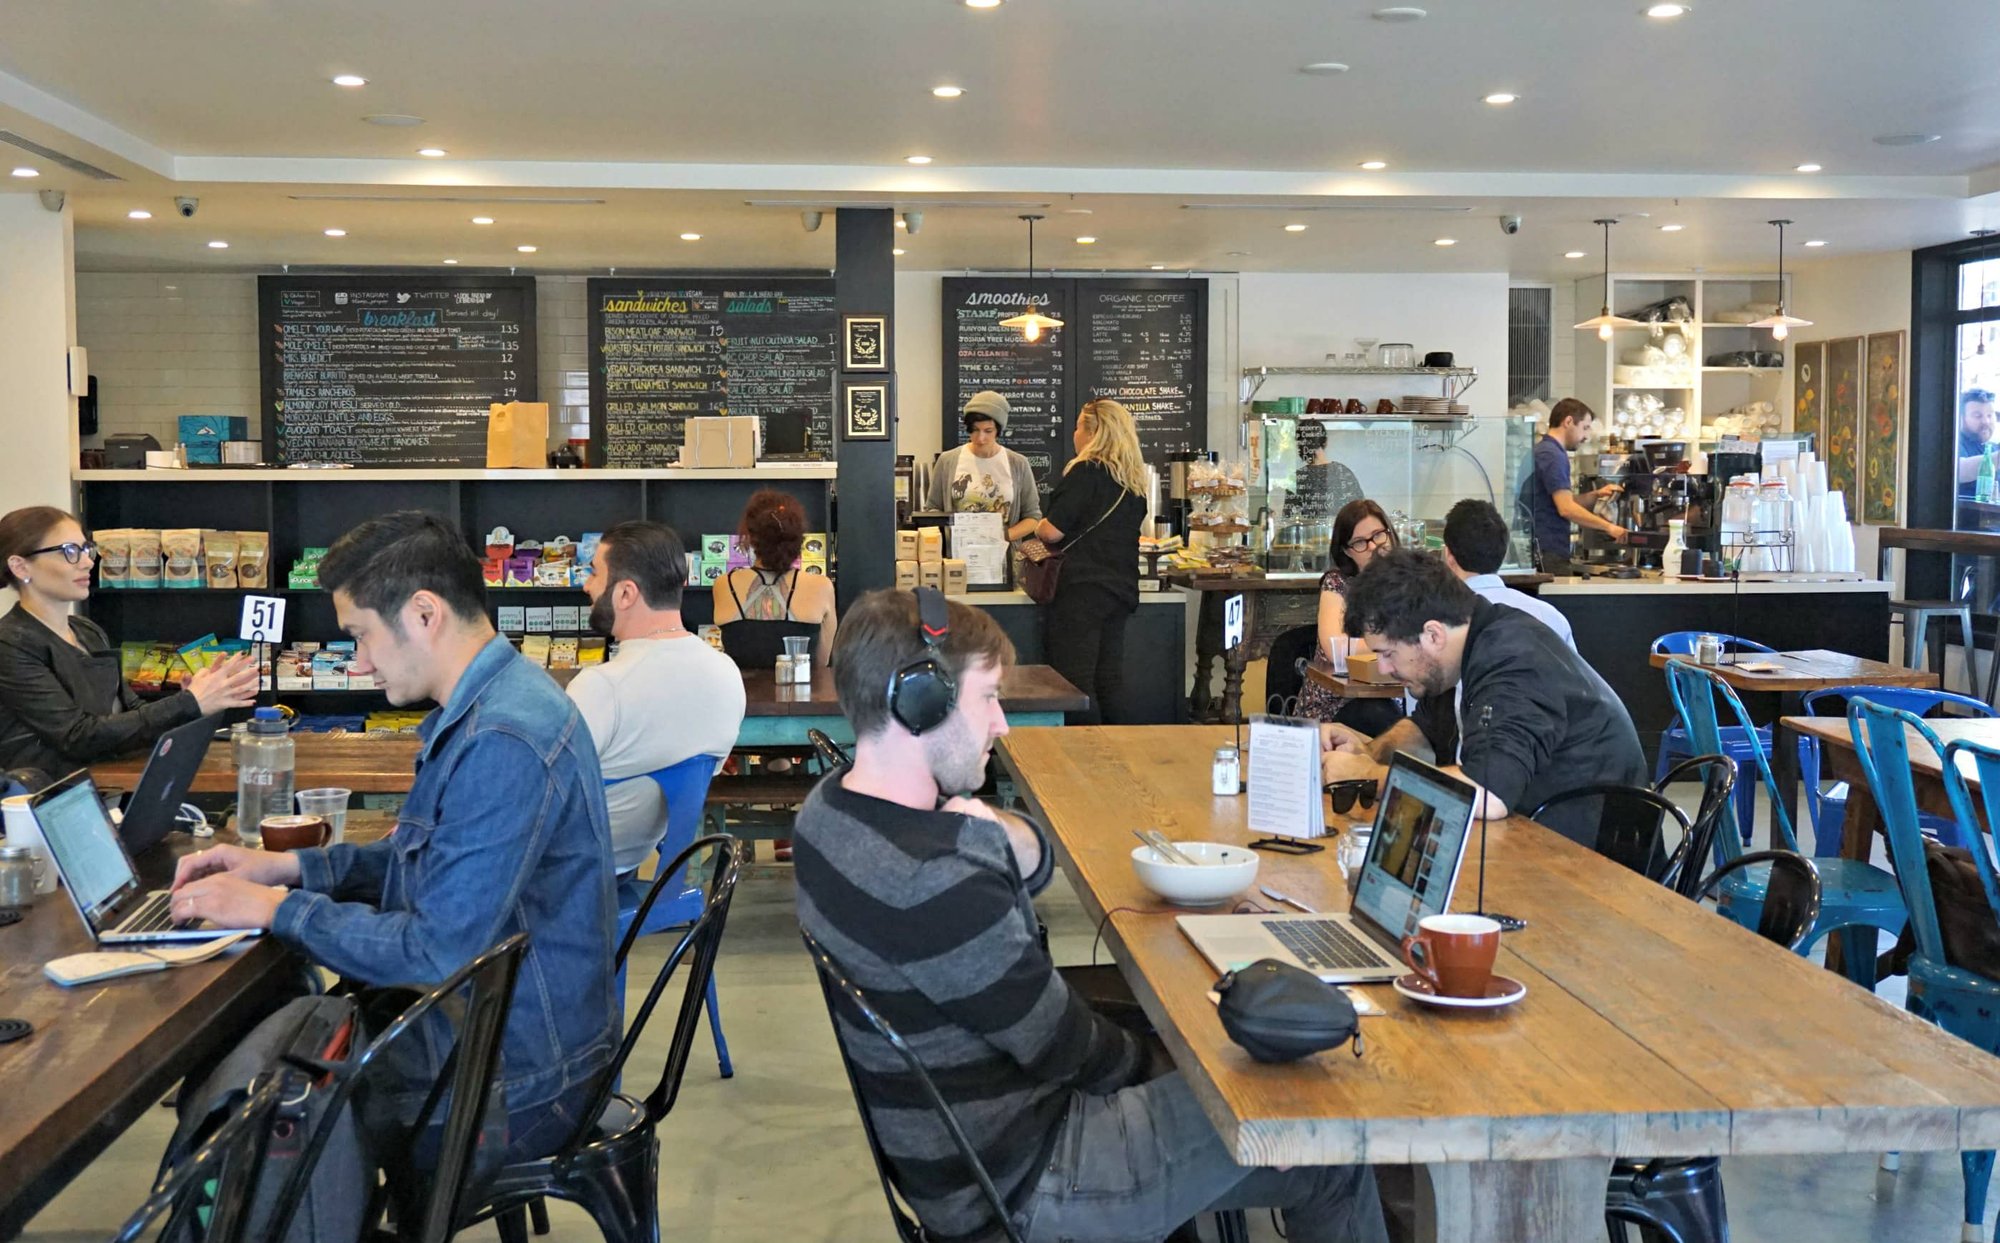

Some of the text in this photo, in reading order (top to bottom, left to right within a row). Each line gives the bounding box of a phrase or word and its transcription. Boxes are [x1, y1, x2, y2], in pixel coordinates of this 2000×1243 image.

[966, 292, 1050, 305] smoothies
[1099, 294, 1186, 303] ORGANIC COFFEE
[605, 297, 689, 313] sandwiches
[726, 298, 774, 313] salads
[363, 308, 436, 327] breakfast
[795, 336, 818, 345] SALAD
[502, 353, 513, 363] 12
[760, 352, 785, 361] SALAD
[665, 365, 702, 374] SANDWICH
[769, 386, 794, 395] SALAD
[1093, 386, 1118, 396] VEGAN
[1119, 386, 1158, 396] CHOCOLATE
[1159, 386, 1179, 396] SHAKE
[1152, 402, 1174, 412] SHAKE
[252, 600, 276, 630] 51
[1229, 600, 1240, 626] 47
